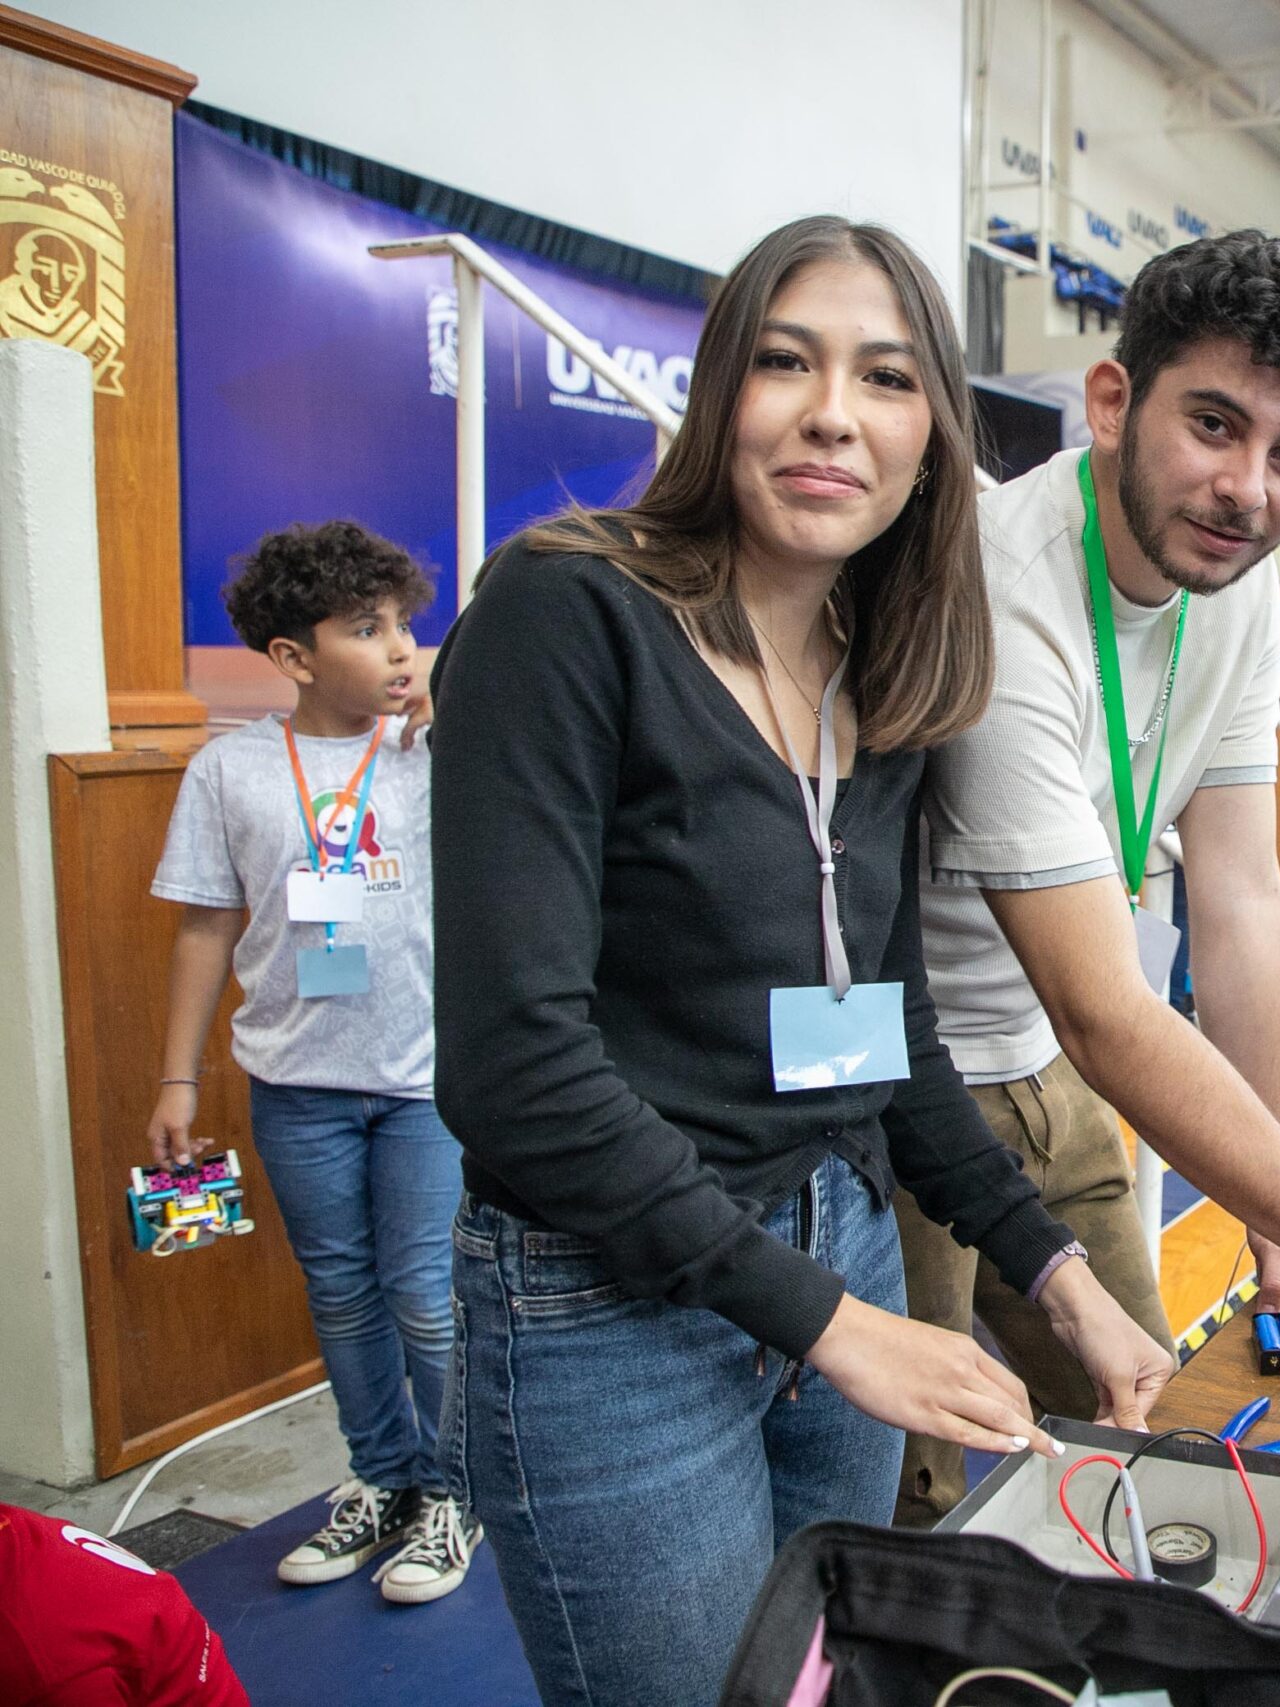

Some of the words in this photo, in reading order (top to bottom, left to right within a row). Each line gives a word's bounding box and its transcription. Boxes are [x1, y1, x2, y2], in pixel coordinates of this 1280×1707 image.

[29, 158, 69, 179] VASCO
[69, 170, 86, 185] DE
[86, 175, 126, 220] QUIROGA
